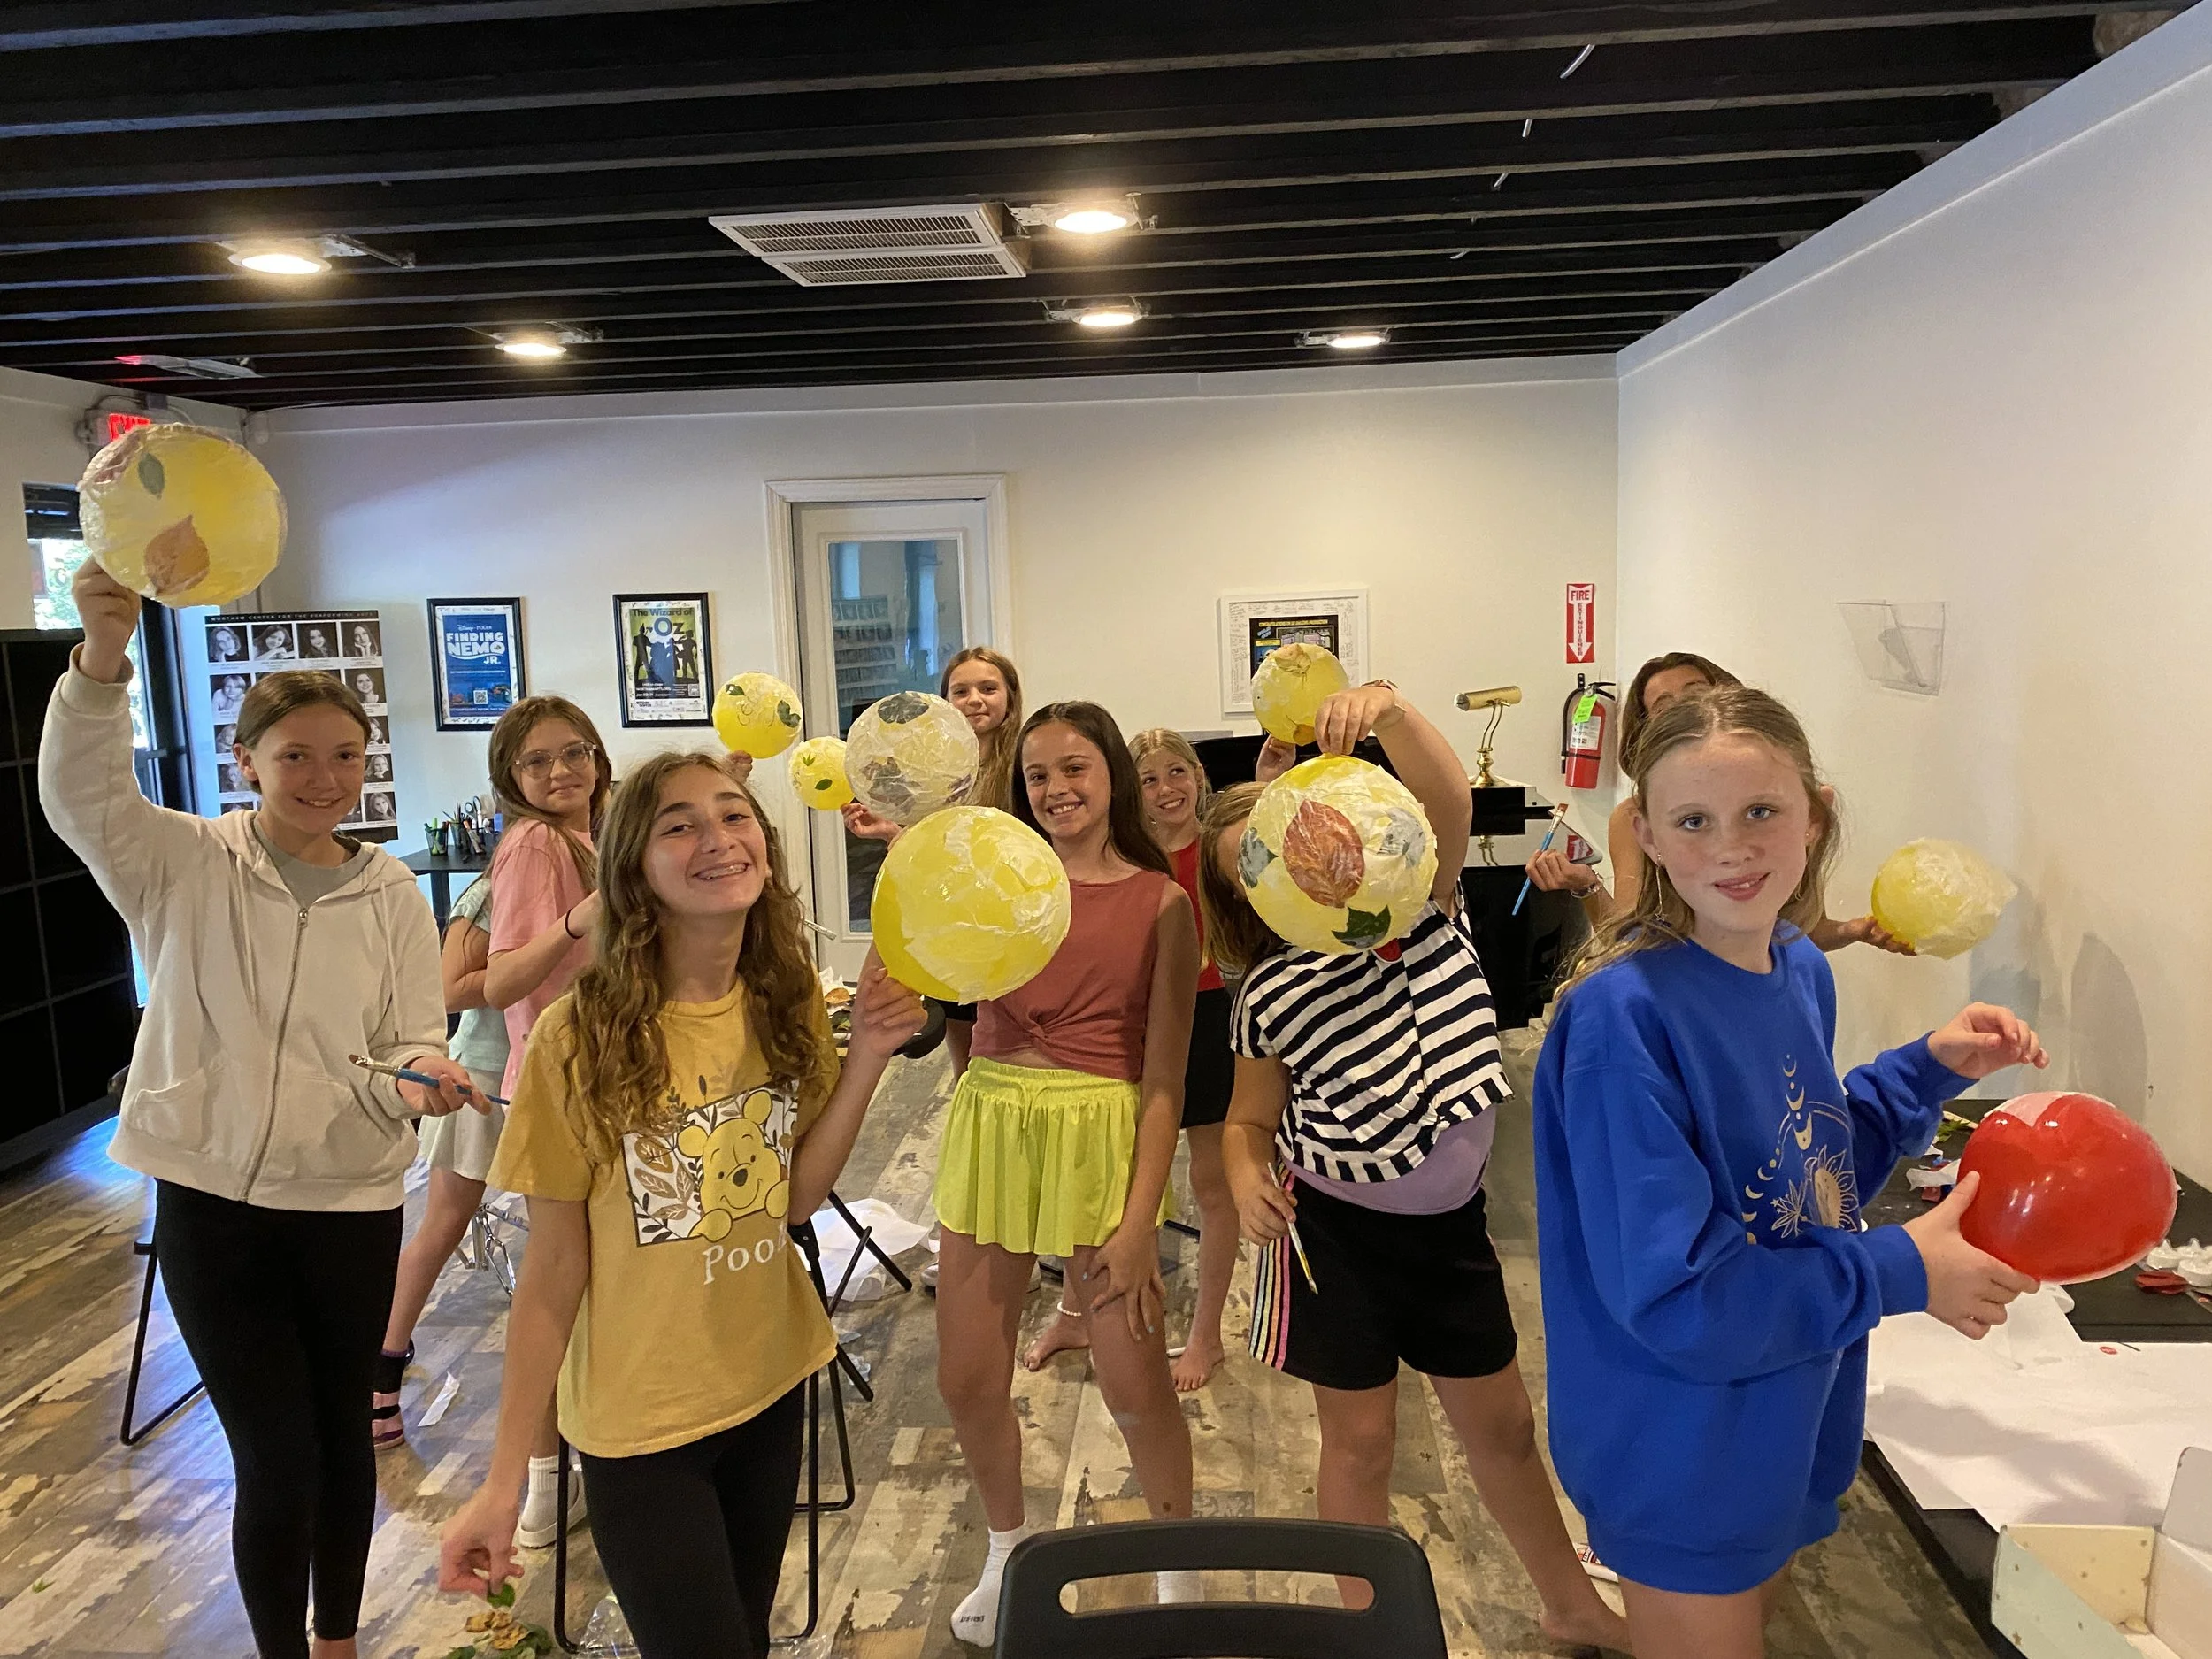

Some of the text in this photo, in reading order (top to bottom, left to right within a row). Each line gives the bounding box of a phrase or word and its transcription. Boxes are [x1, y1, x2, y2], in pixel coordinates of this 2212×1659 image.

[1571, 589, 1591, 601] FIRE
[446, 632, 504, 642] FINDING
[447, 641, 505, 656] NEMO
[483, 655, 502, 664] JR.
